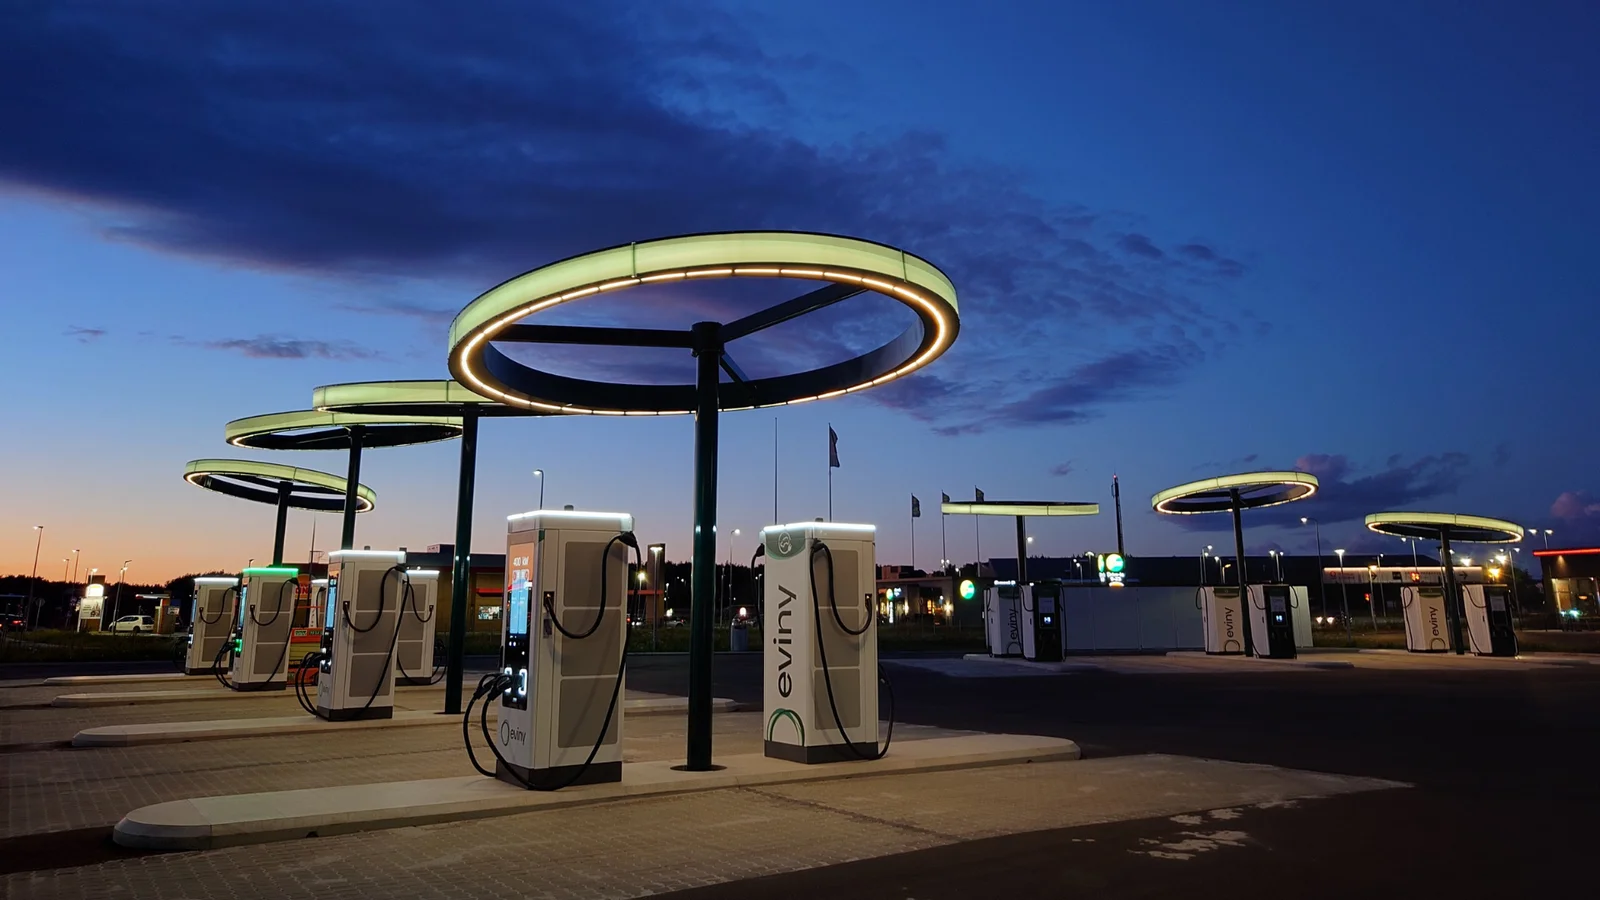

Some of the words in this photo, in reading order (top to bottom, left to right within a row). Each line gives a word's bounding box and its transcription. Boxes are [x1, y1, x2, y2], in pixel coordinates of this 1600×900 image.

[1008, 608, 1019, 640] eviny
[1224, 607, 1234, 638] eviny
[1429, 606, 1440, 637] eviny
[773, 584, 797, 698] eviny
[510, 726, 527, 746] eviny
